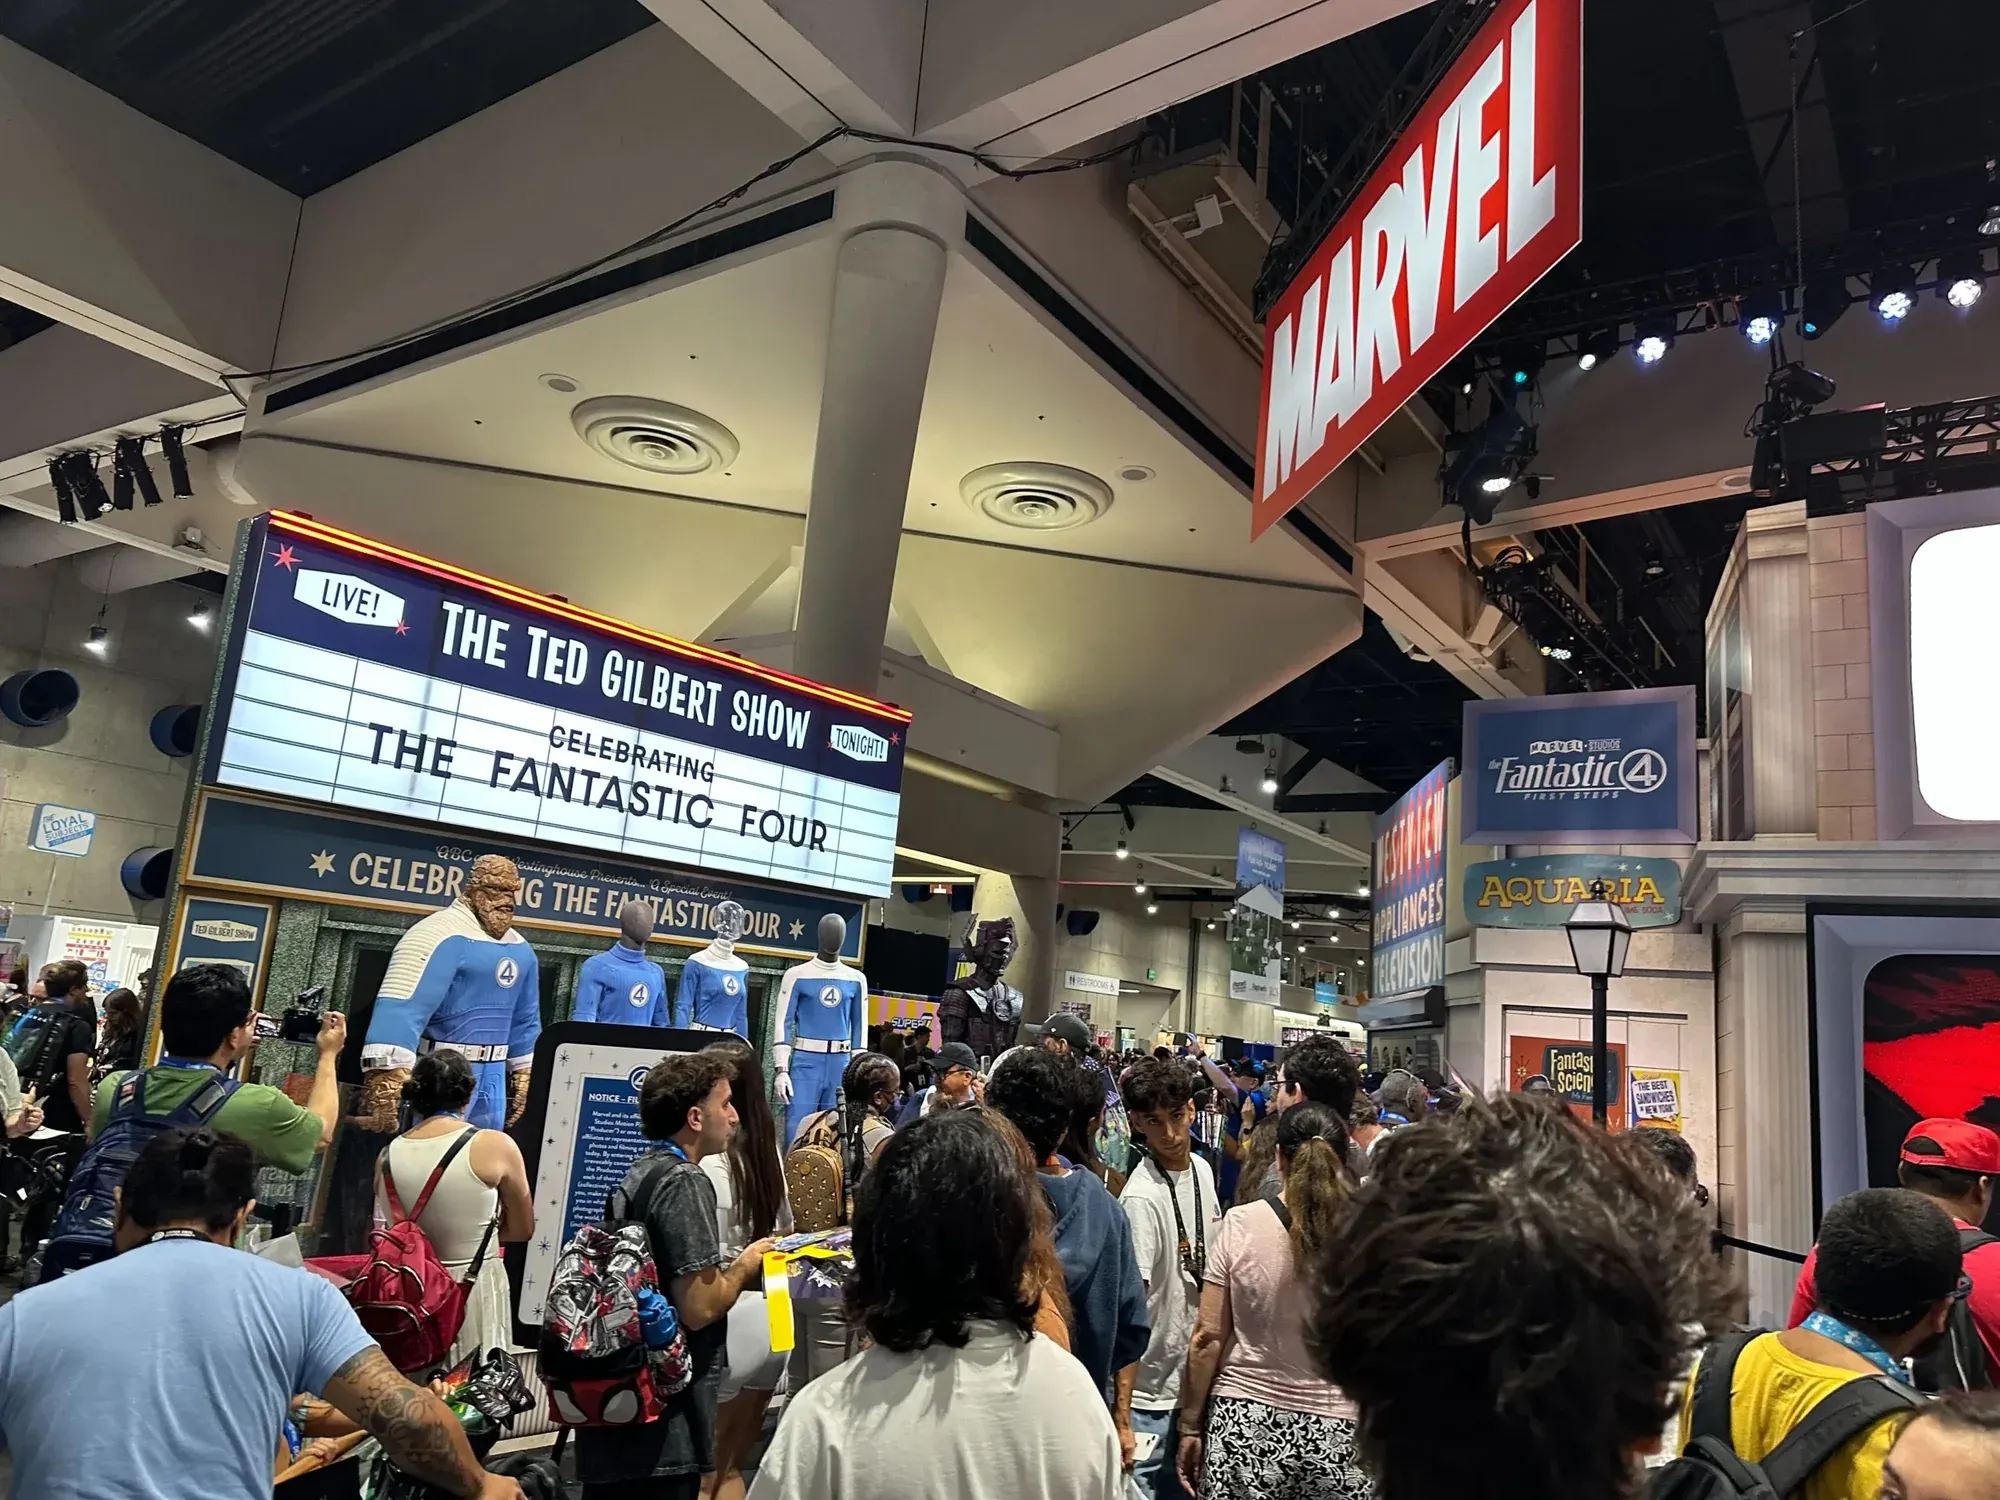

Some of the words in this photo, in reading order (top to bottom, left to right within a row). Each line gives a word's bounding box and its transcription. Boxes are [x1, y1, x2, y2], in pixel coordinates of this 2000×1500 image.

[1262, 0, 1557, 502] MARVEL
[321, 579, 380, 618] LIVE!
[442, 600, 510, 669] THE
[527, 626, 588, 686] TED
[601, 649, 722, 726] GILBERT
[731, 690, 811, 750] SHOW
[836, 728, 884, 760] TONIGHT!
[1531, 740, 1582, 753] MARVEL
[1588, 739, 1620, 750] STUDIOS
[549, 725, 714, 783] CELEBRATING
[1488, 759, 1501, 770] the
[1495, 754, 1620, 793] Fantastic
[1625, 753, 1658, 786] 4
[368, 722, 457, 779] THE
[489, 750, 714, 829] FANTASTIC
[740, 804, 828, 853] FOUR
[1524, 792, 1566, 800] FIRST
[1574, 791, 1620, 800] STEPS
[43, 813, 87, 834] LOYAL
[46, 822, 88, 841] SUBJECTS
[1375, 786, 1445, 889] WESTVIEW
[350, 852, 544, 909] CELEBRNG
[552, 881, 600, 916] THE
[742, 909, 781, 939] OUR
[661, 879, 700, 897] Special
[700, 886, 732, 901] Event!
[1374, 877, 1444, 946] APPLIANCES
[195, 925, 207, 934] TED
[208, 926, 234, 937] GILBERT
[235, 929, 255, 939] SHOW
[500, 961, 514, 983] 4
[1373, 933, 1444, 994] TELEVISION
[726, 978, 736, 992] 4
[1076, 977, 1109, 989] RESTROOMS
[633, 985, 645, 1002] 4
[824, 988, 836, 1004] 4
[1550, 1049, 1594, 1080] Fantast
[1557, 1072, 1594, 1093] Scien
[1651, 1080, 1667, 1090] BEST
[588, 1093, 620, 1102] NOTICE
[627, 1096, 640, 1104] FIL
[1636, 1091, 1674, 1104] SANDWICHES
[1645, 1105, 1657, 1114] NEW
[585, 1150, 601, 1158] today.
[602, 1151, 610, 1159] By
[611, 1152, 633, 1160] entering
[619, 1145, 637, 1153] filming
[584, 1158, 613, 1166] irrevocably
[596, 1167, 623, 1175] Producers,
[572, 1206, 605, 1214] photograph
